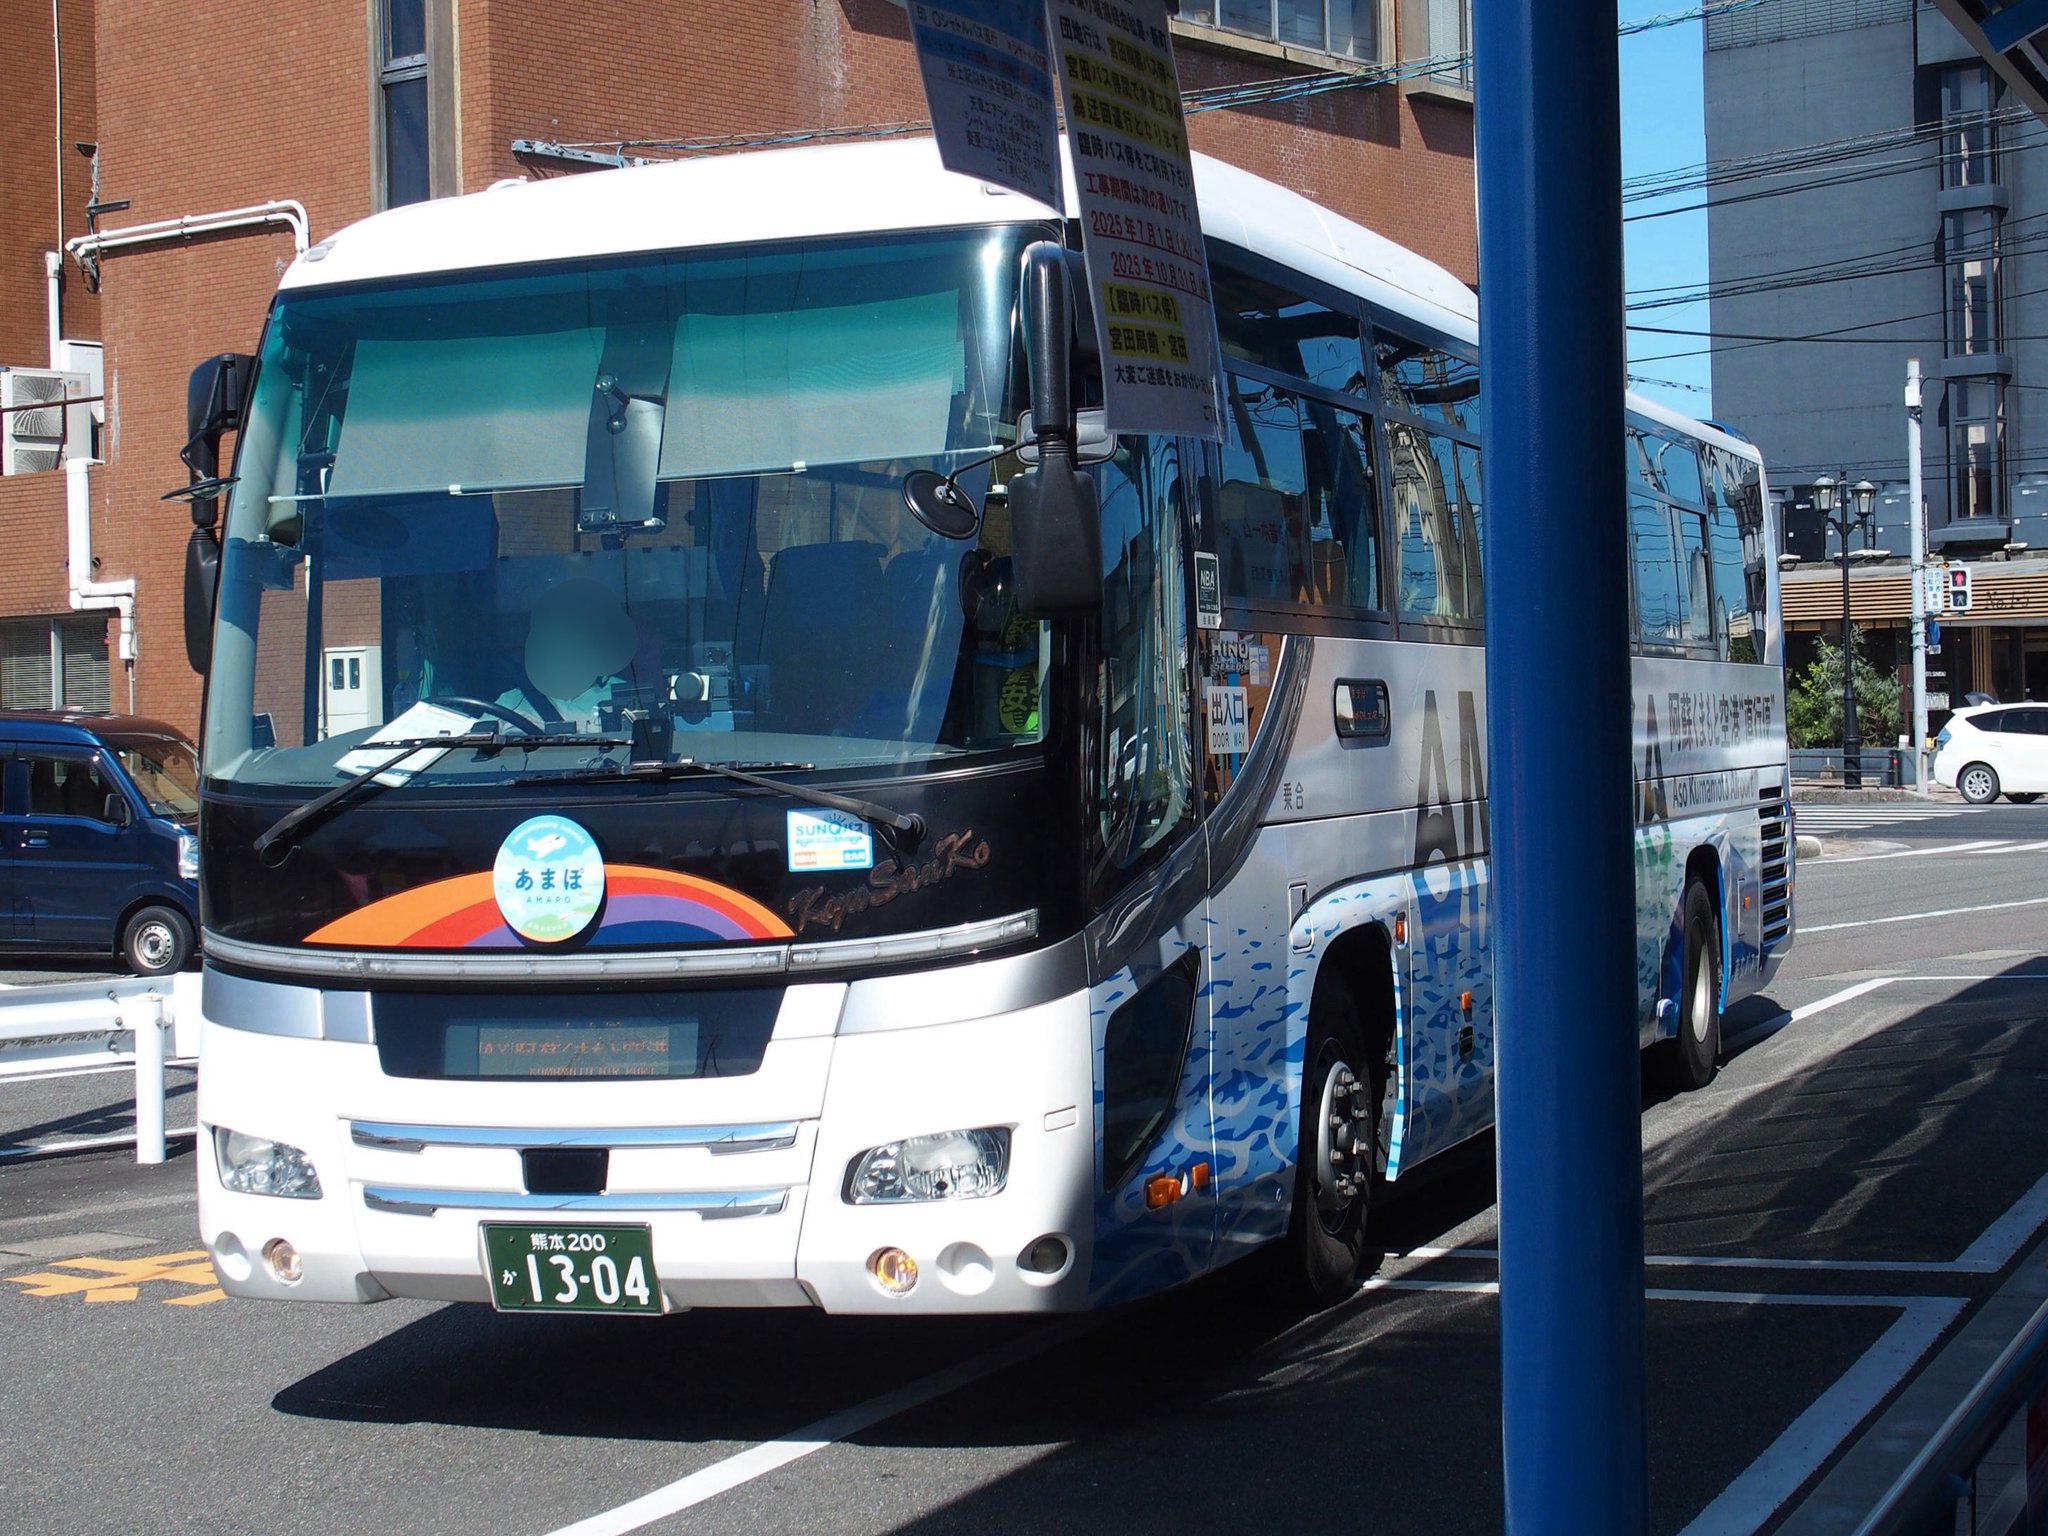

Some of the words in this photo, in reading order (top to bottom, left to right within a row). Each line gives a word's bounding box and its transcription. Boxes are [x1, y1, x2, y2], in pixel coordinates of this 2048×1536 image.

[1211, 692, 1246, 728] 出入口
[1212, 732, 1230, 749] DOOR
[1234, 731, 1246, 748] WAY
[515, 868, 585, 891] あまぽ
[526, 896, 571, 904] AMAPO
[502, 1269, 518, 1287] か
[526, 1253, 650, 1305] 13-04
